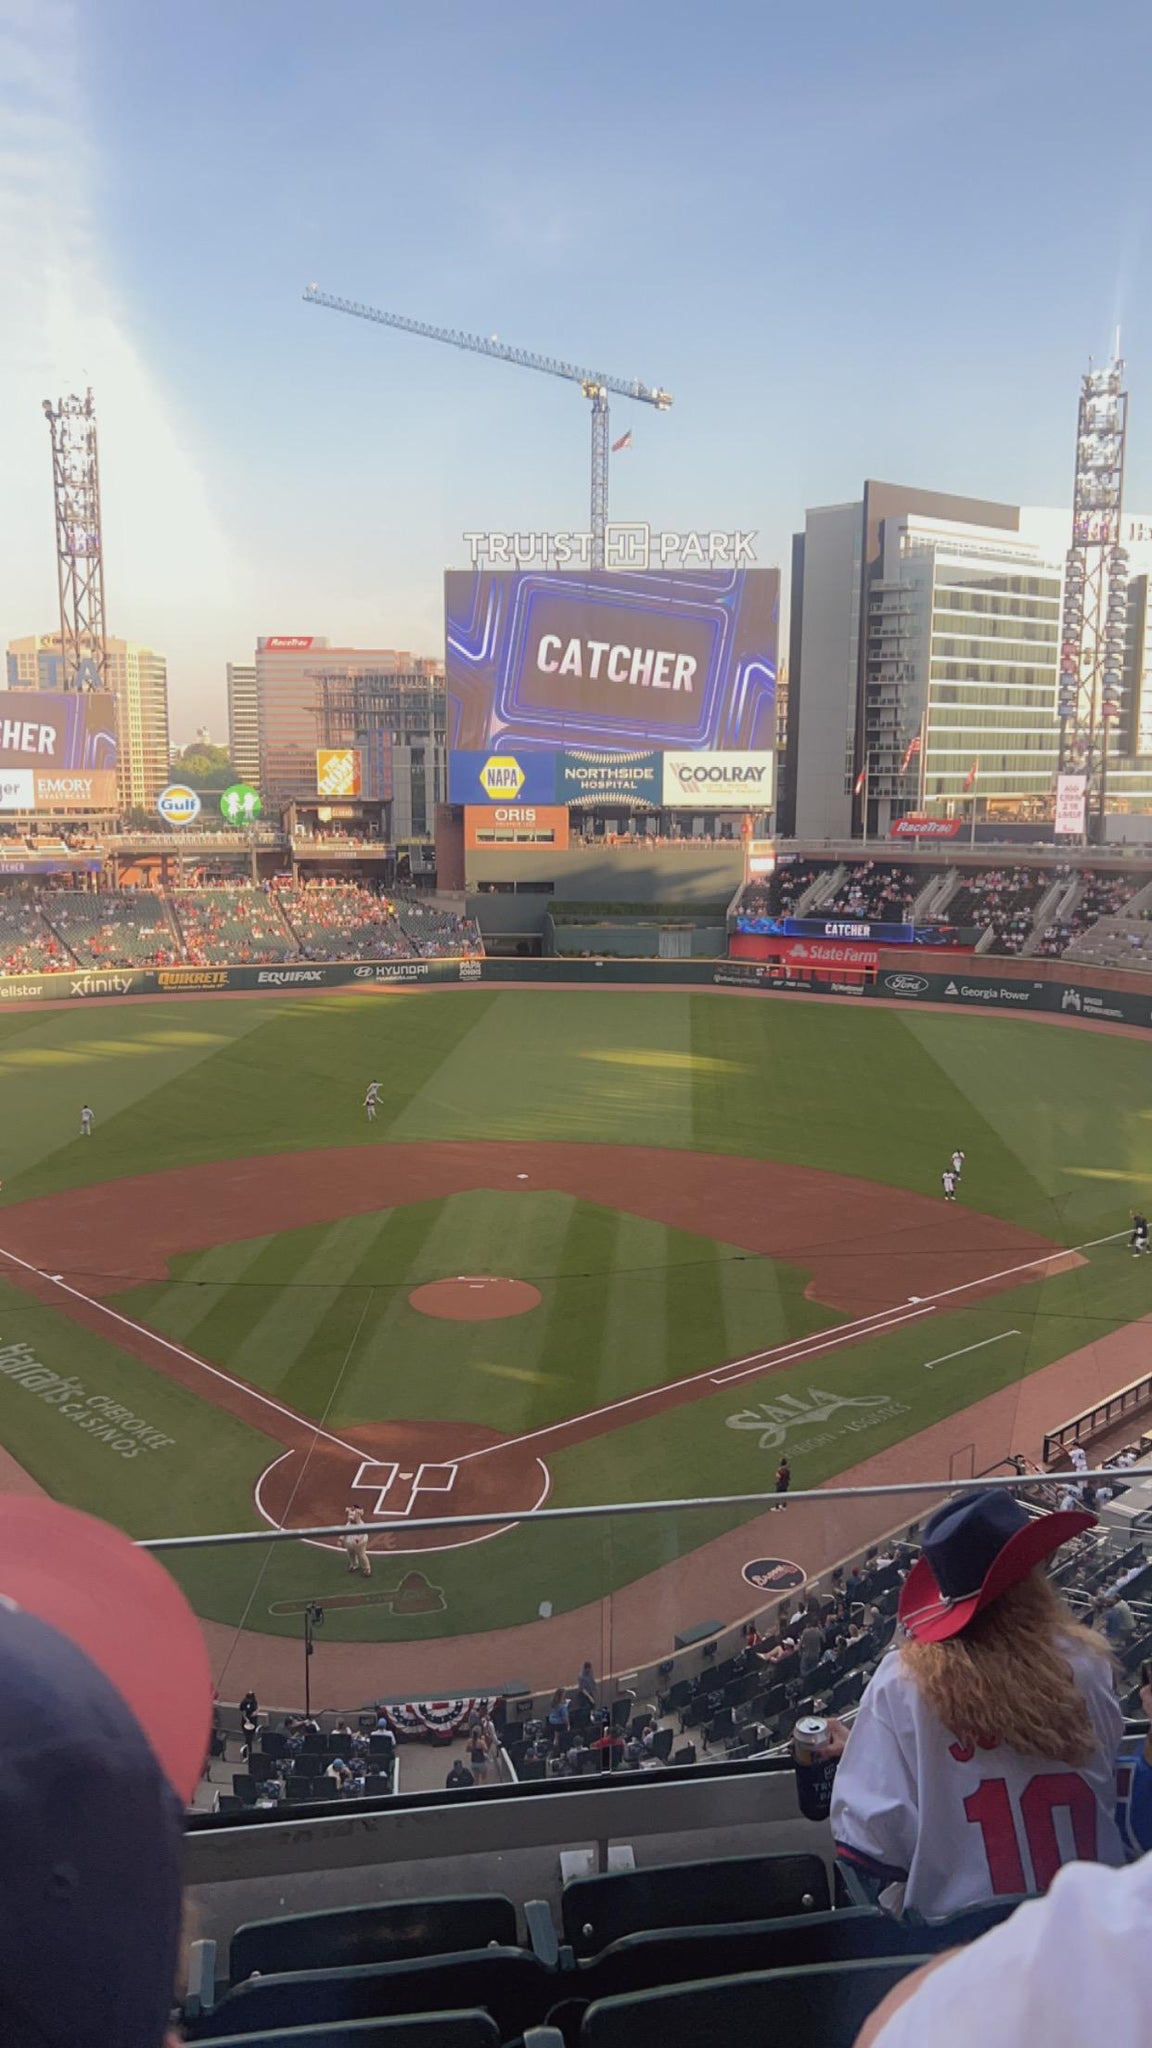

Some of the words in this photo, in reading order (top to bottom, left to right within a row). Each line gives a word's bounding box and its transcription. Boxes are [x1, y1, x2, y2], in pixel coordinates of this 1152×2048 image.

[463, 531, 594, 563] TRUIST
[659, 530, 758, 562] PARK
[536, 633, 698, 693] CATCHER
[0, 718, 57, 755] HER
[487, 768, 517, 787] NAPA
[564, 768, 654, 780] NORTHSIDE
[678, 766, 767, 783] COOLRAY
[37, 778, 93, 792] EMORY
[580, 780, 638, 790] HOSPITAL
[161, 798, 196, 811] Gulf
[495, 808, 536, 822] ORIS
[896, 822, 952, 832] RaceTrac
[824, 923, 871, 937] CATCHER
[376, 965, 429, 975] HYUNDAI
[158, 972, 229, 985] QUIKRETE
[257, 971, 323, 984] EQUIFAX
[892, 976, 921, 990] Ford
[0, 984, 43, 998] ellstar
[70, 975, 134, 996] xfinity
[960, 986, 998, 1000] Georgia
[1000, 989, 1030, 1000] Power
[85, 1395, 176, 1450] CHEROKEE
[725, 1386, 891, 1449] SAIA
[58, 1402, 147, 1459] CASINOS
[963, 1771, 1098, 1896] 10
